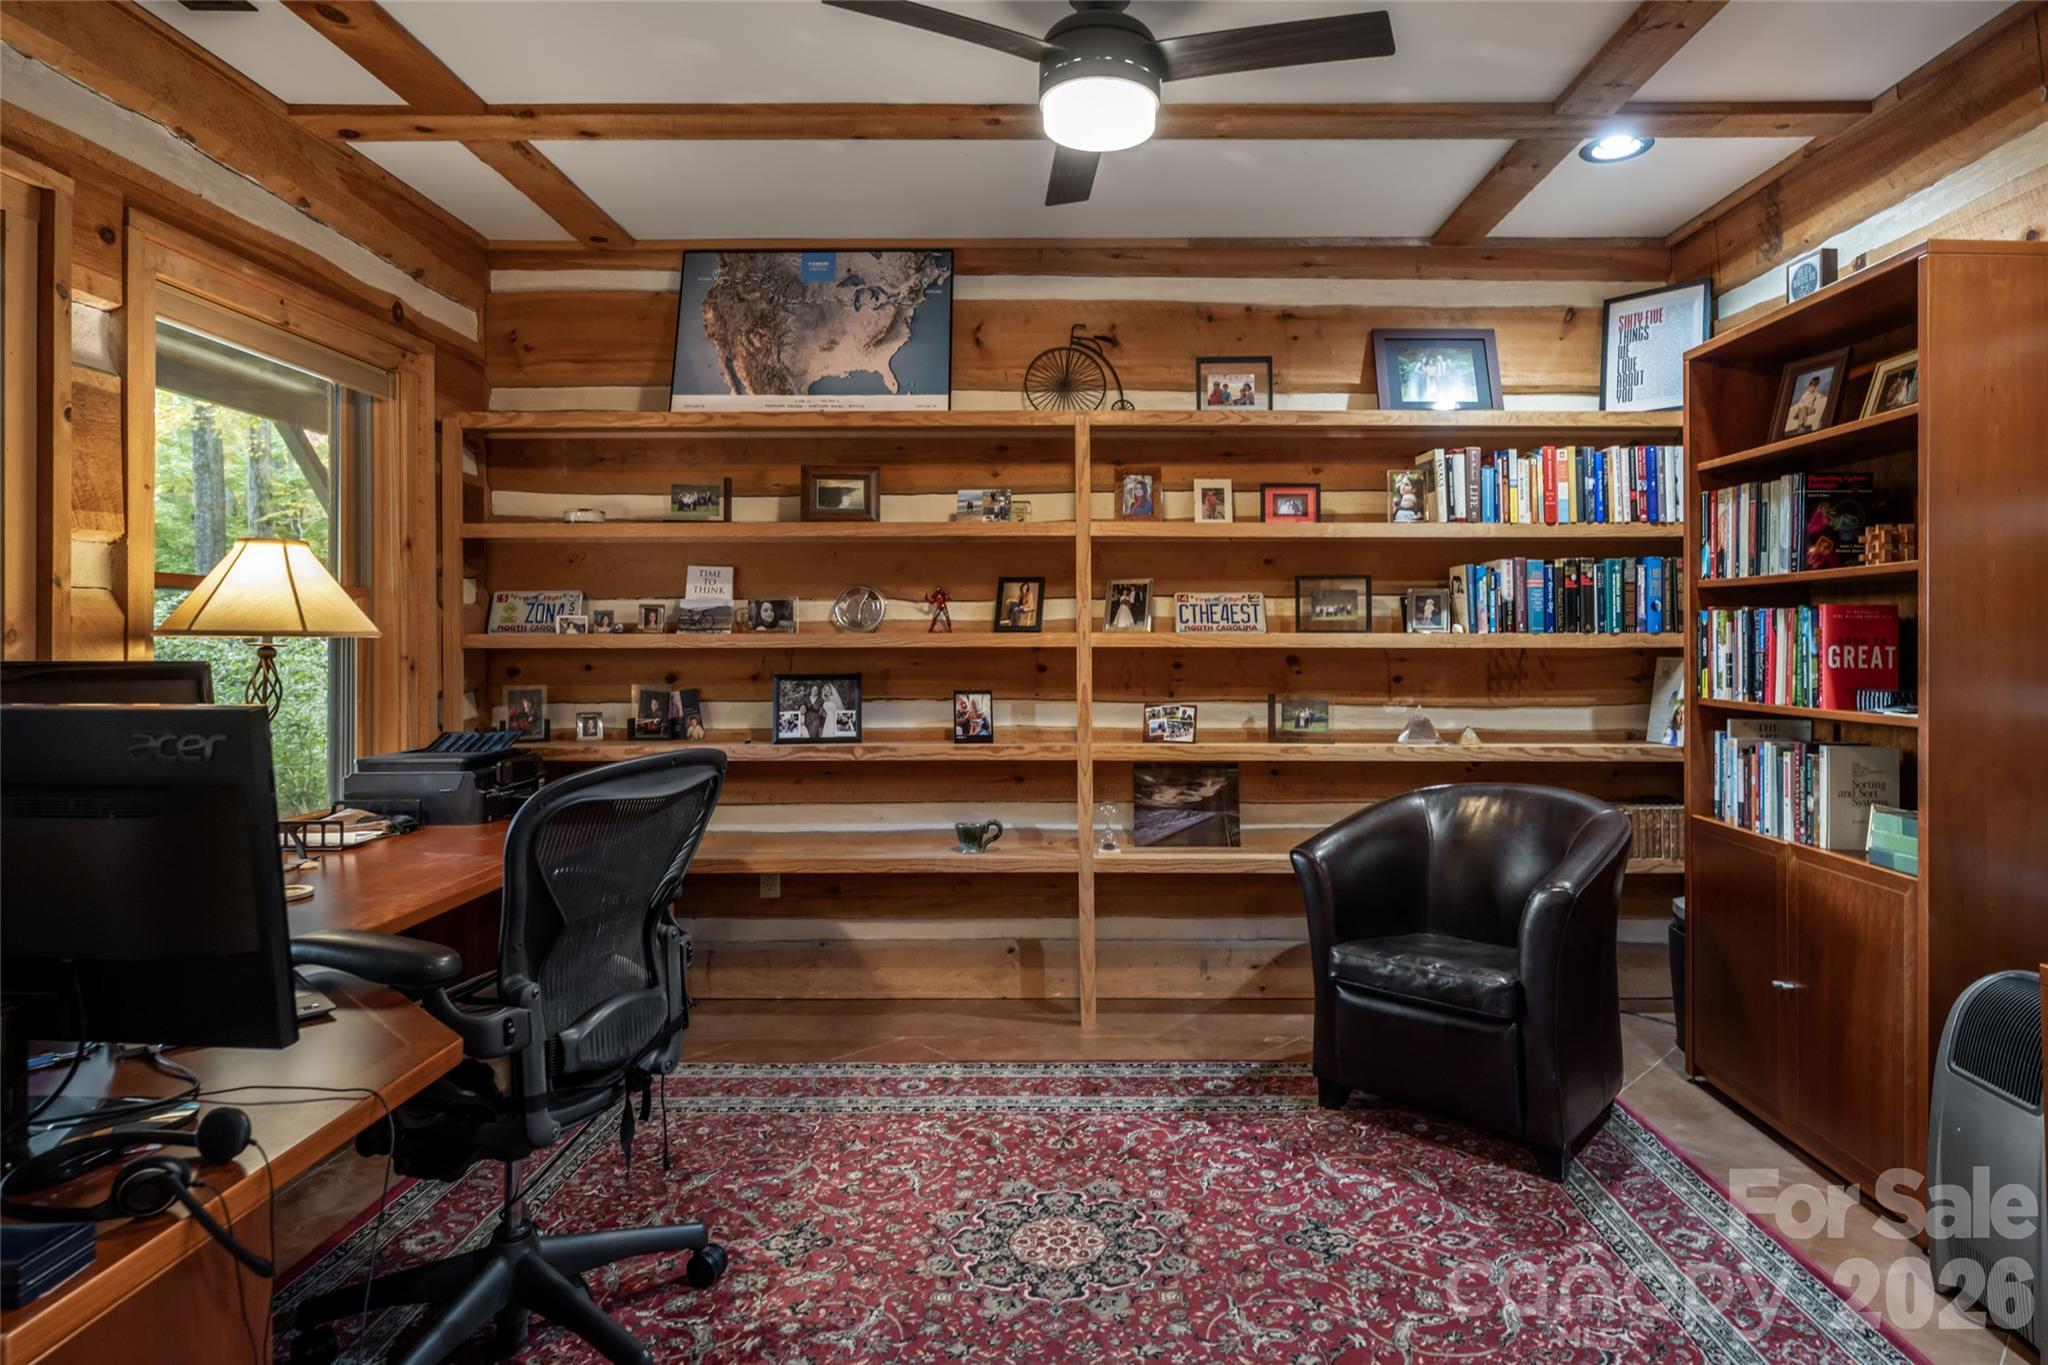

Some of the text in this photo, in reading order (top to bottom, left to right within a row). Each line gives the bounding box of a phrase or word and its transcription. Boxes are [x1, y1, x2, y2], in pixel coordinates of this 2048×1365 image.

[1619, 325, 1650, 344] THINGS
[1618, 343, 1630, 360] WE
[1617, 357, 1638, 374] LOVE
[1616, 370, 1645, 388] ABOUT
[1616, 386, 1633, 404] YOU
[698, 569, 721, 578] TIME
[703, 577, 717, 586] TO
[694, 586, 726, 595] THINK
[1184, 624, 1258, 632] NORTH CAROLINA
[1827, 644, 1896, 669] GREAT
[127, 733, 228, 762] acer
[1838, 789, 1878, 799] and Sort
[1851, 779, 1887, 792] Sorting
